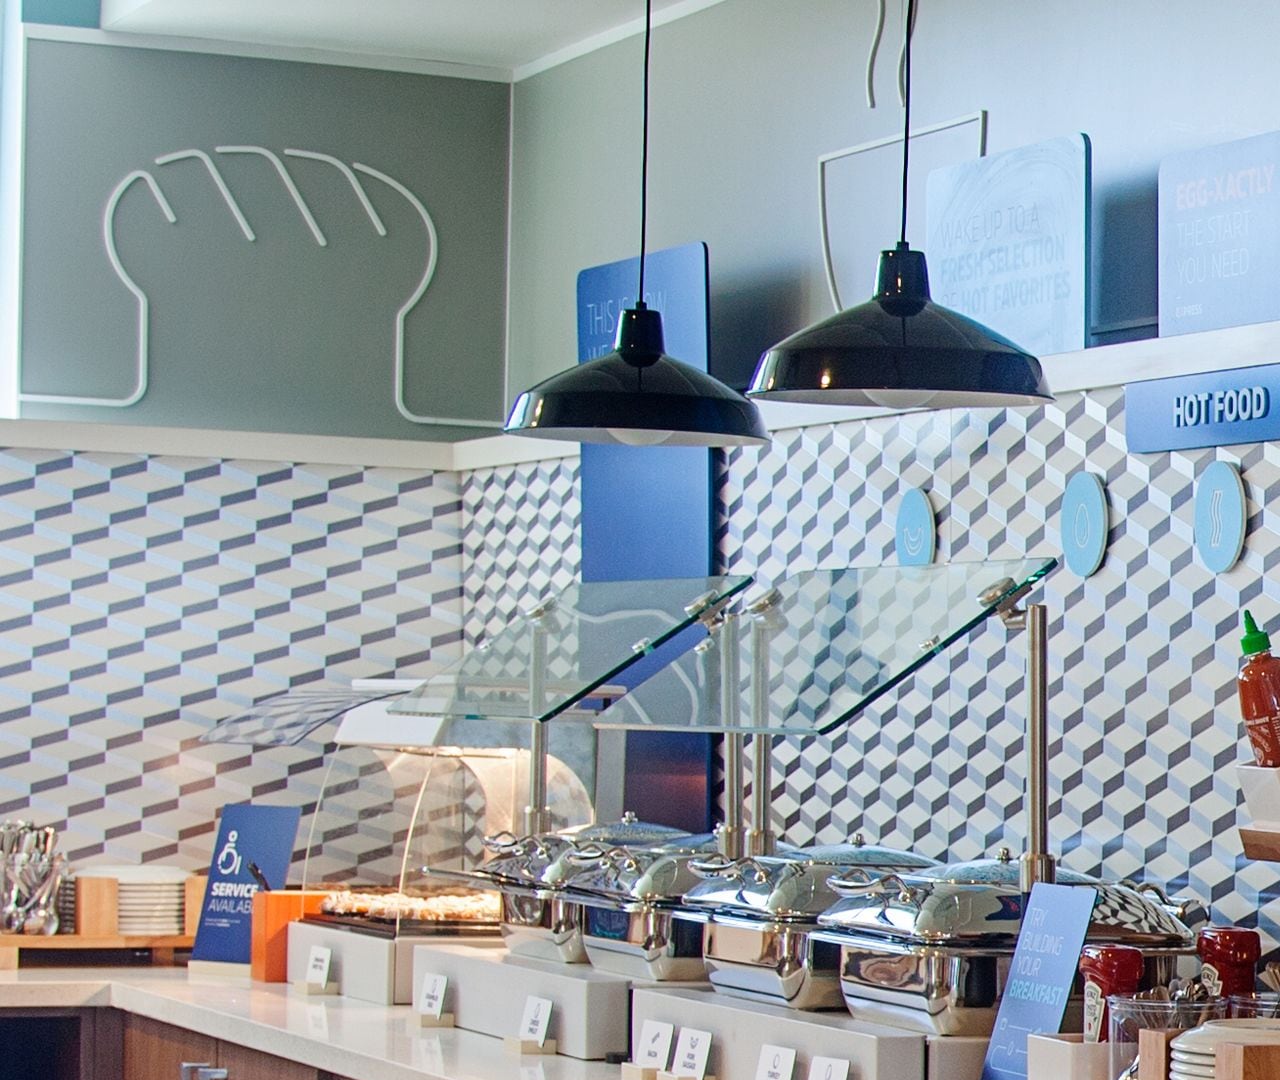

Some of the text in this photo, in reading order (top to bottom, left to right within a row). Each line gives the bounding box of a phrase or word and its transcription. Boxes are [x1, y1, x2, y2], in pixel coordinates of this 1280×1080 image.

[1176, 163, 1275, 210] EGG-XACTLY
[941, 202, 1041, 248] WAKE UP TO A
[1177, 209, 1250, 247] THE START
[940, 233, 1065, 284] FRESH SELECTION
[1176, 247, 1249, 285] YOU NEED
[961, 285, 990, 315] HOT
[993, 271, 1071, 312] FAVORITES
[587, 300, 614, 335] THIS
[1172, 386, 1269, 428] HOT FOOD
[207, 899, 254, 914] AVAILAB
[211, 882, 259, 898] SERVICE
[1030, 907, 1047, 928] TRY
[1022, 931, 1065, 956] BUILDING
[1016, 956, 1041, 977] YOUR
[1009, 979, 1064, 1006] BREAKFAST
